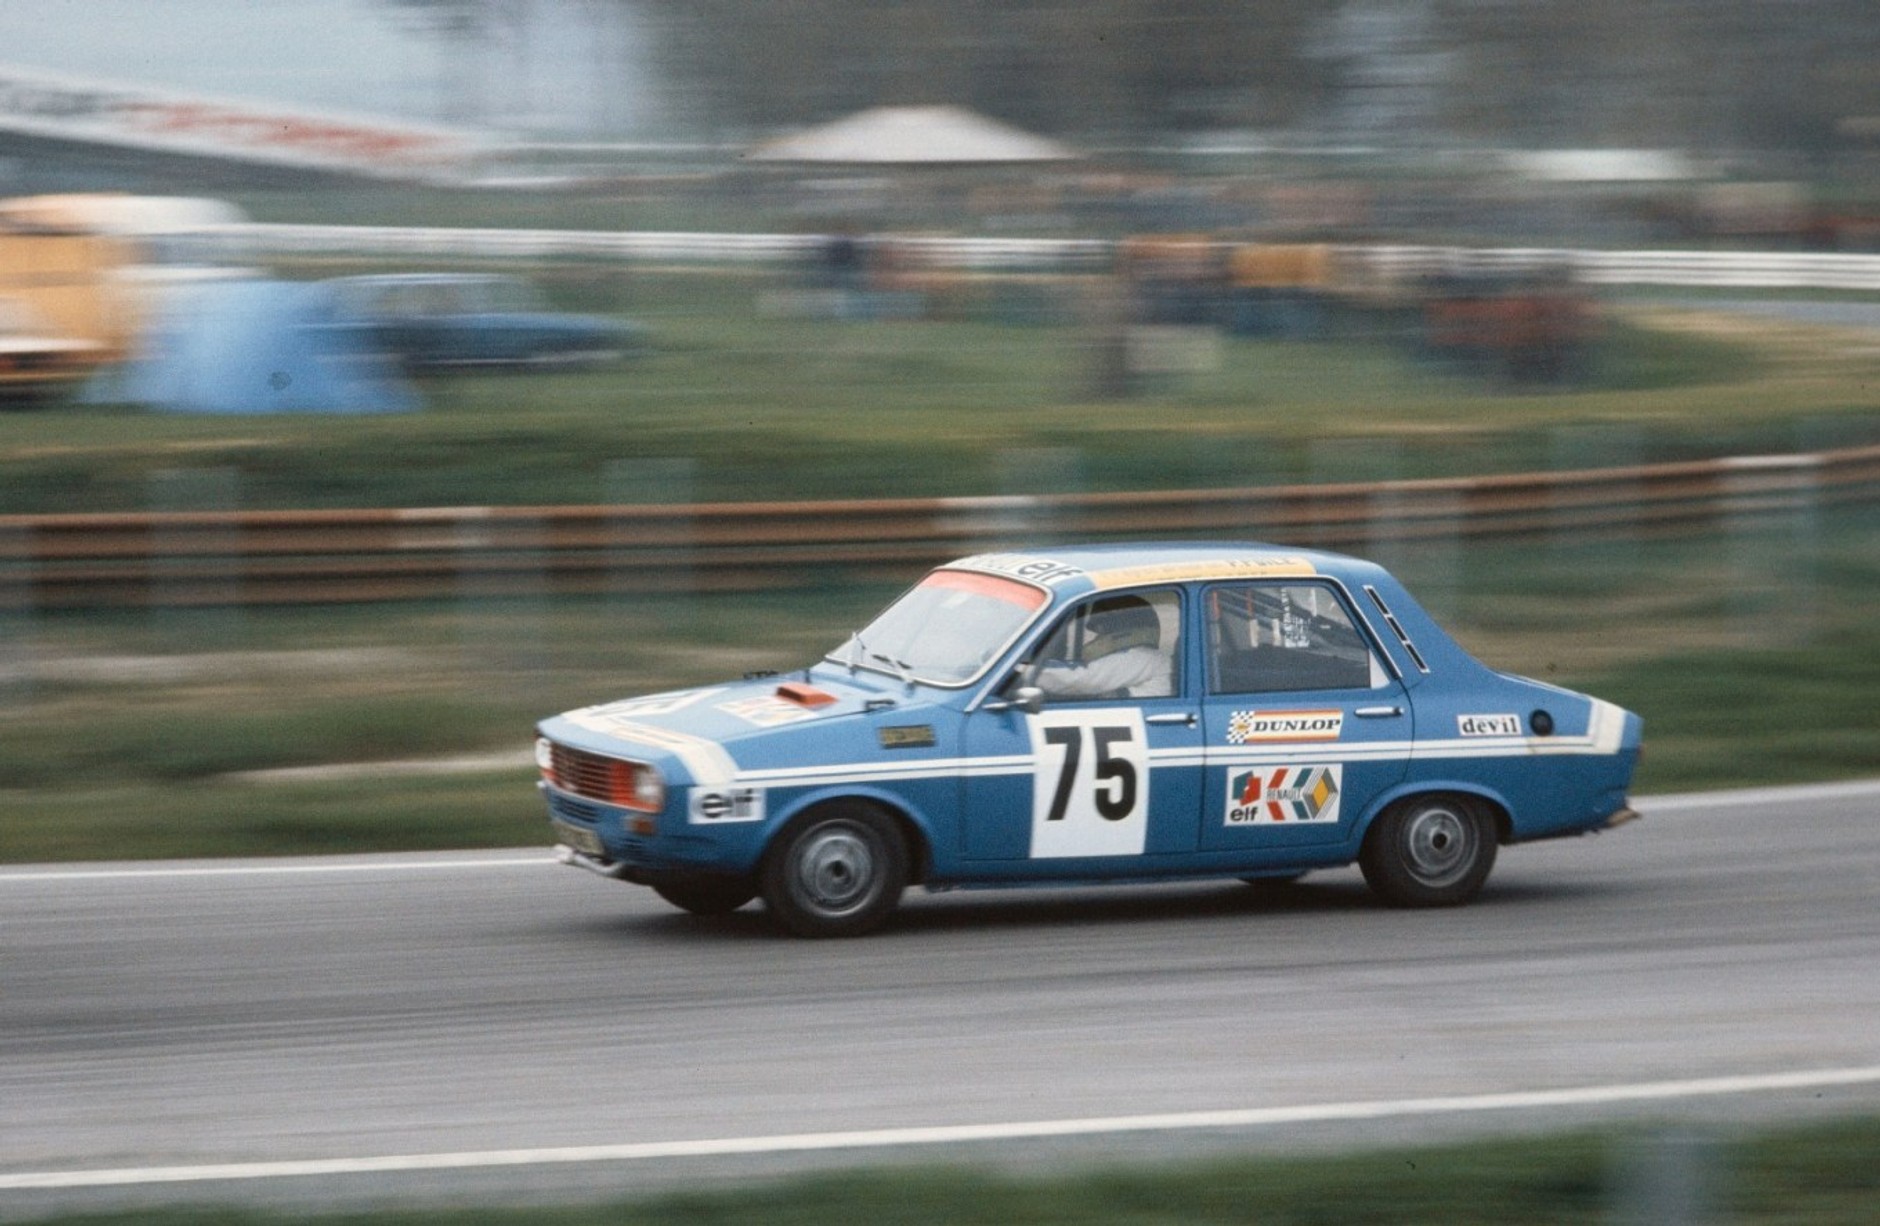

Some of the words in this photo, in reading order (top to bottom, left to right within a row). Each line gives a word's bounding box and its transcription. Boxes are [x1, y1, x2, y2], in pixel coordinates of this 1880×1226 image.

[1018, 562, 1083, 581] elf
[1253, 719, 1341, 732] DUNLOP
[1462, 717, 1517, 734] devil
[1043, 726, 1137, 821] 75
[699, 788, 756, 818] elf
[1229, 806, 1258, 822] elf
